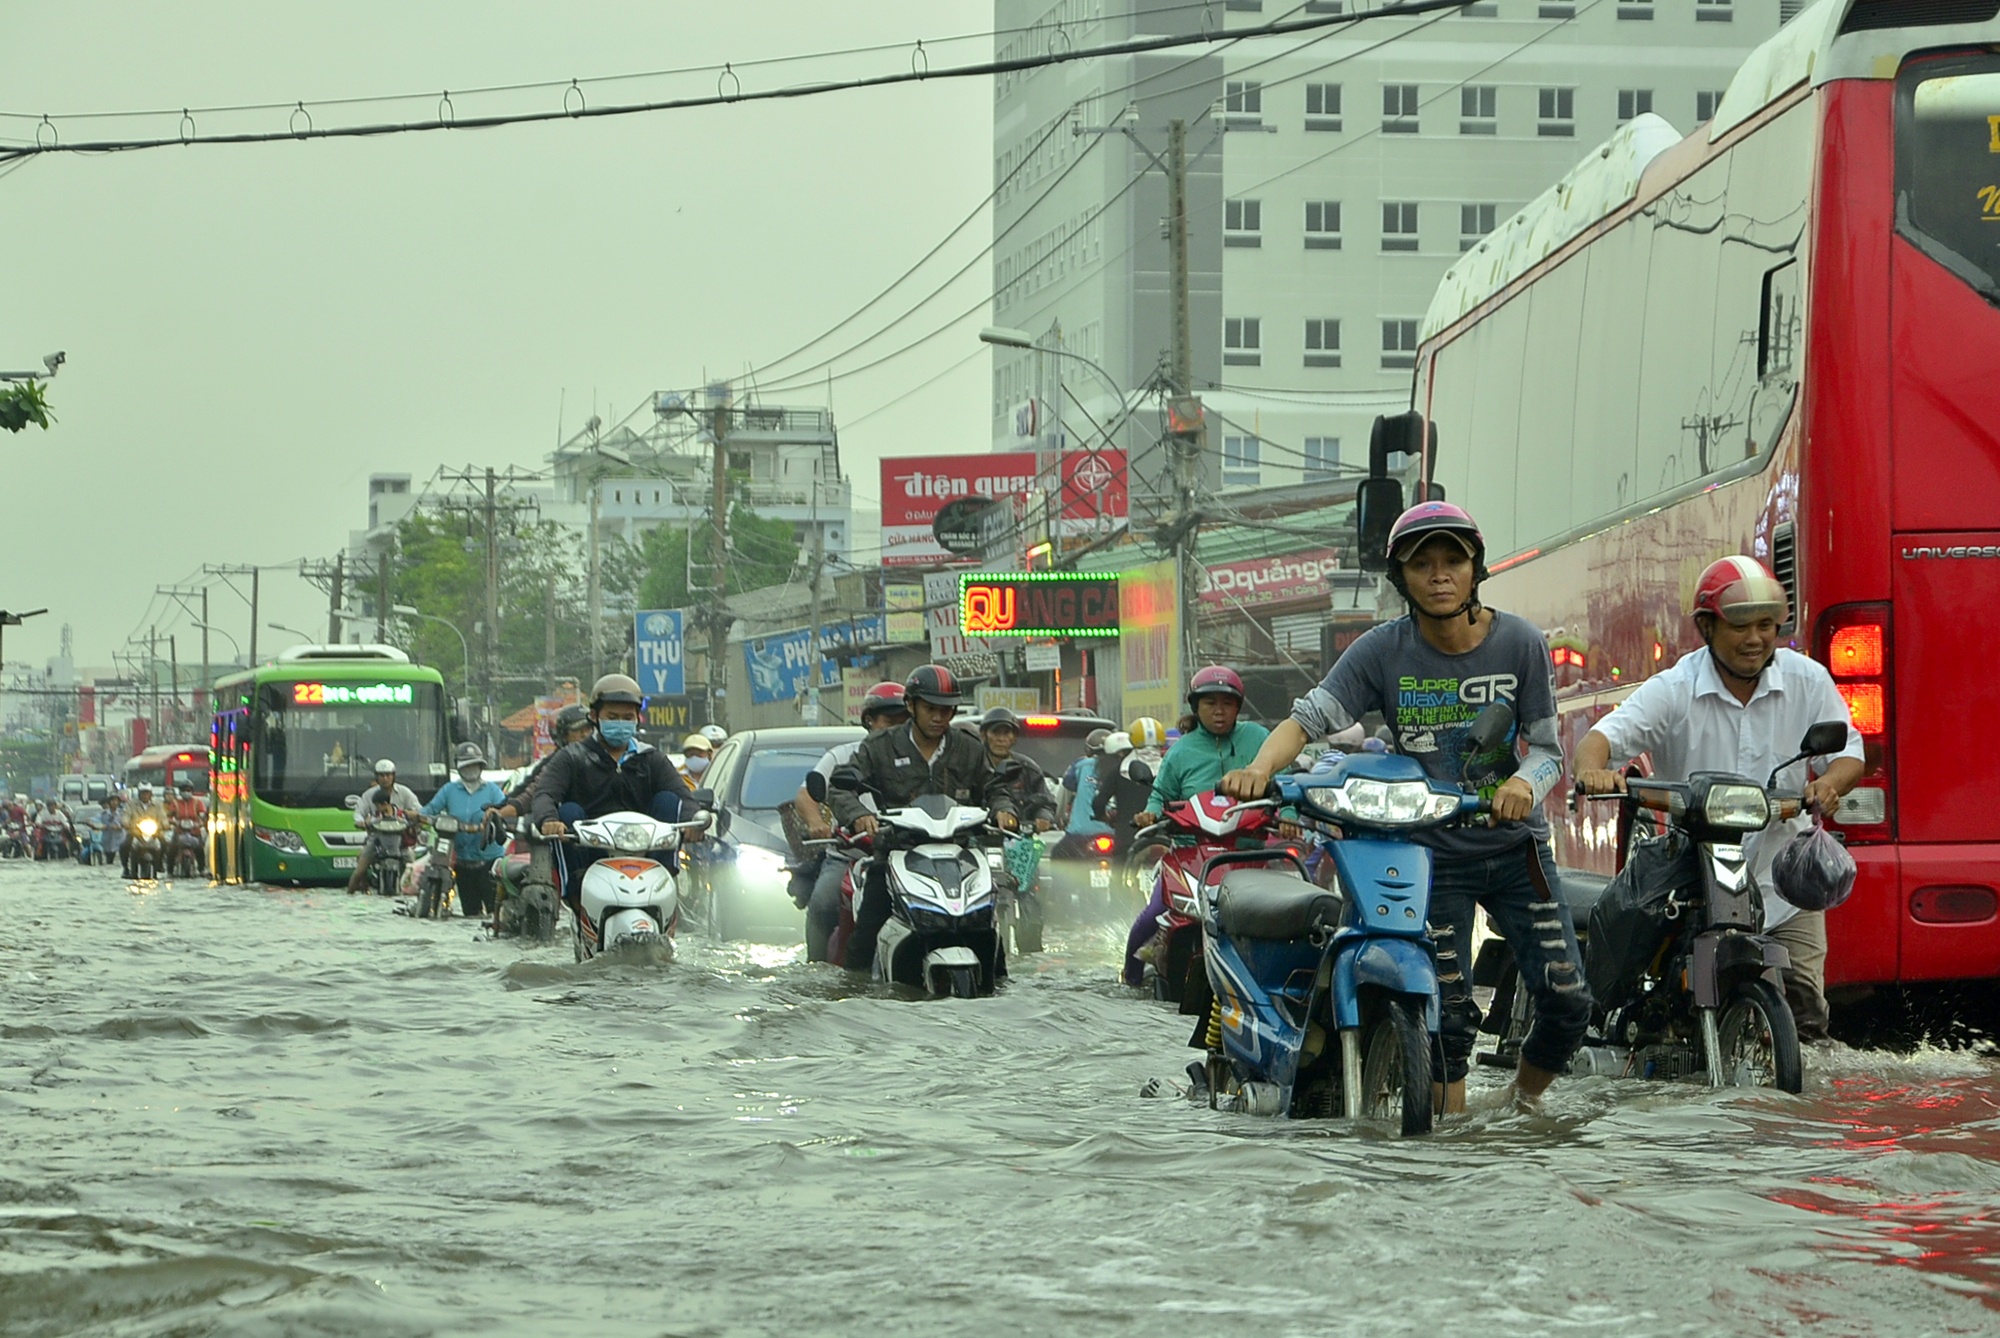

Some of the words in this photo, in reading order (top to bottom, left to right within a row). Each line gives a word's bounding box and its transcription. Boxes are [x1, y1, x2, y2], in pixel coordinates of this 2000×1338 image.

[1902, 546, 2000, 559] UNIVERS
[653, 669, 668, 693] Y
[1459, 674, 1518, 704] GR
[294, 684, 322, 704] 22
[677, 706, 687, 725] Y
[1397, 707, 1419, 717] THE
[1422, 704, 1468, 715] INFINITY
[1397, 716, 1412, 724] OF
[1415, 714, 1436, 725] THE
[1439, 712, 1457, 722] BIG
